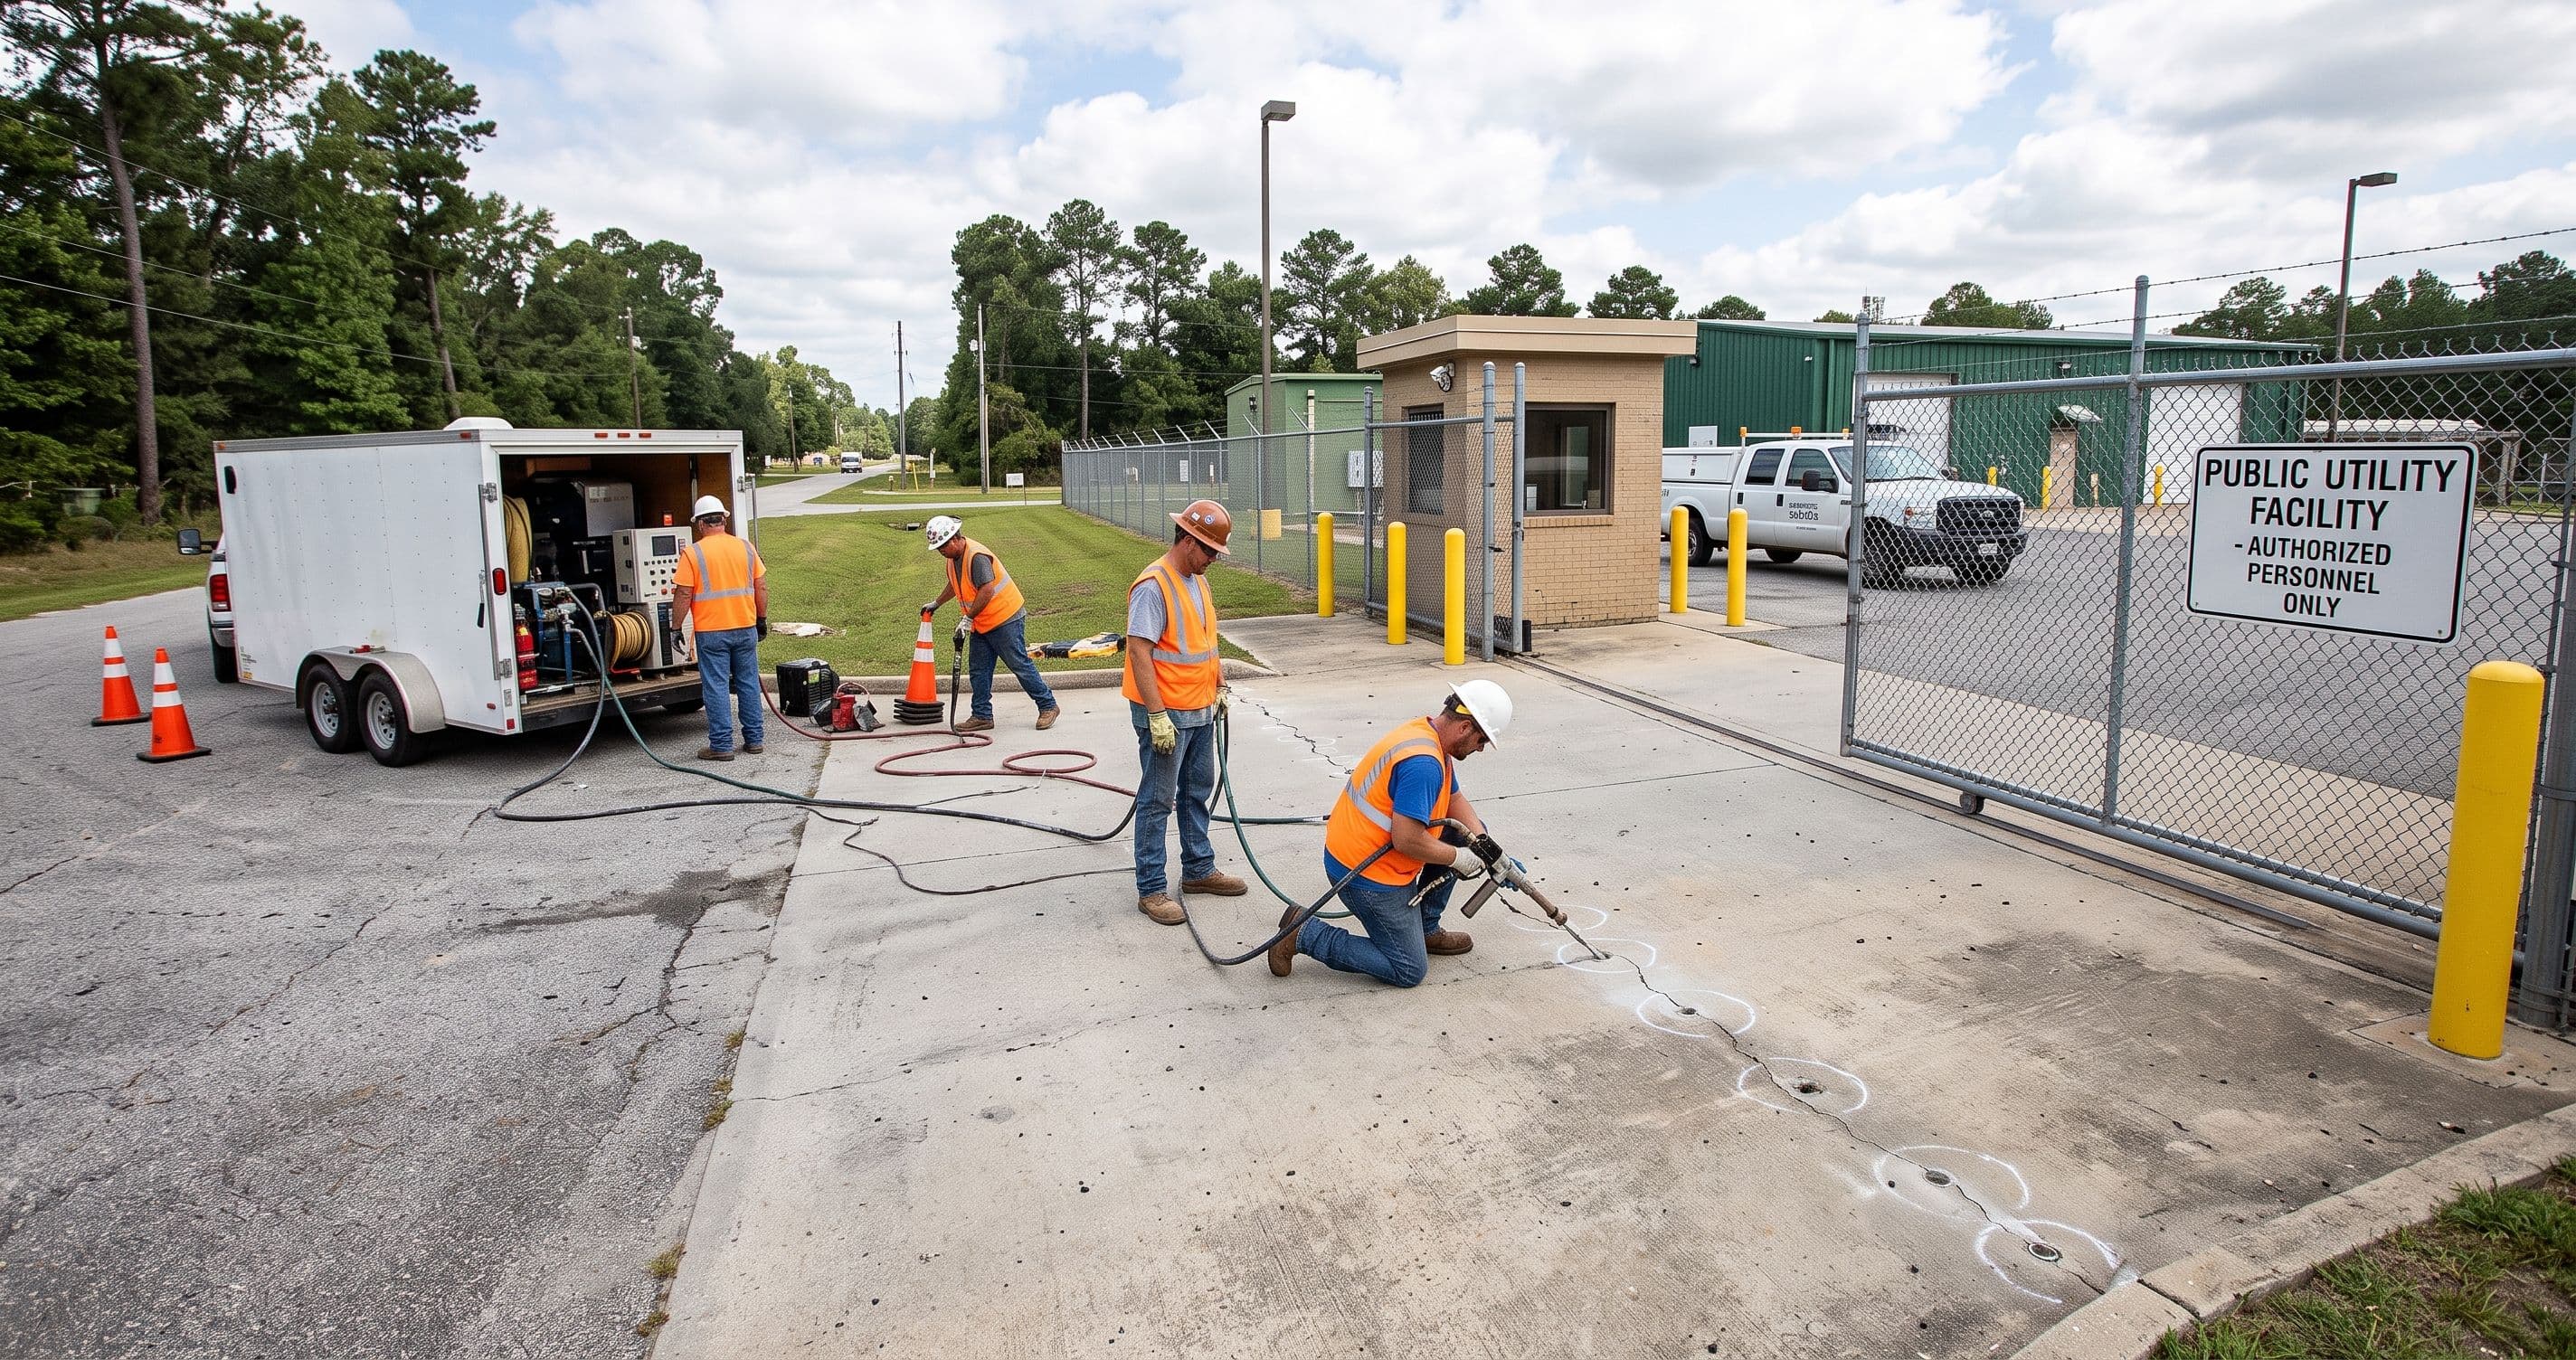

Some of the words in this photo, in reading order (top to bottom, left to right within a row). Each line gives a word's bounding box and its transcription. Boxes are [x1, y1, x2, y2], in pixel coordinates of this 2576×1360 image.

[2205, 458, 2309, 489] PUBLIC
[2325, 459, 2458, 493] UTILITY
[2249, 496, 2390, 531] FACILITY
[2248, 562, 2381, 595] PERSONNEL
[2283, 592, 2342, 618] ONLY
